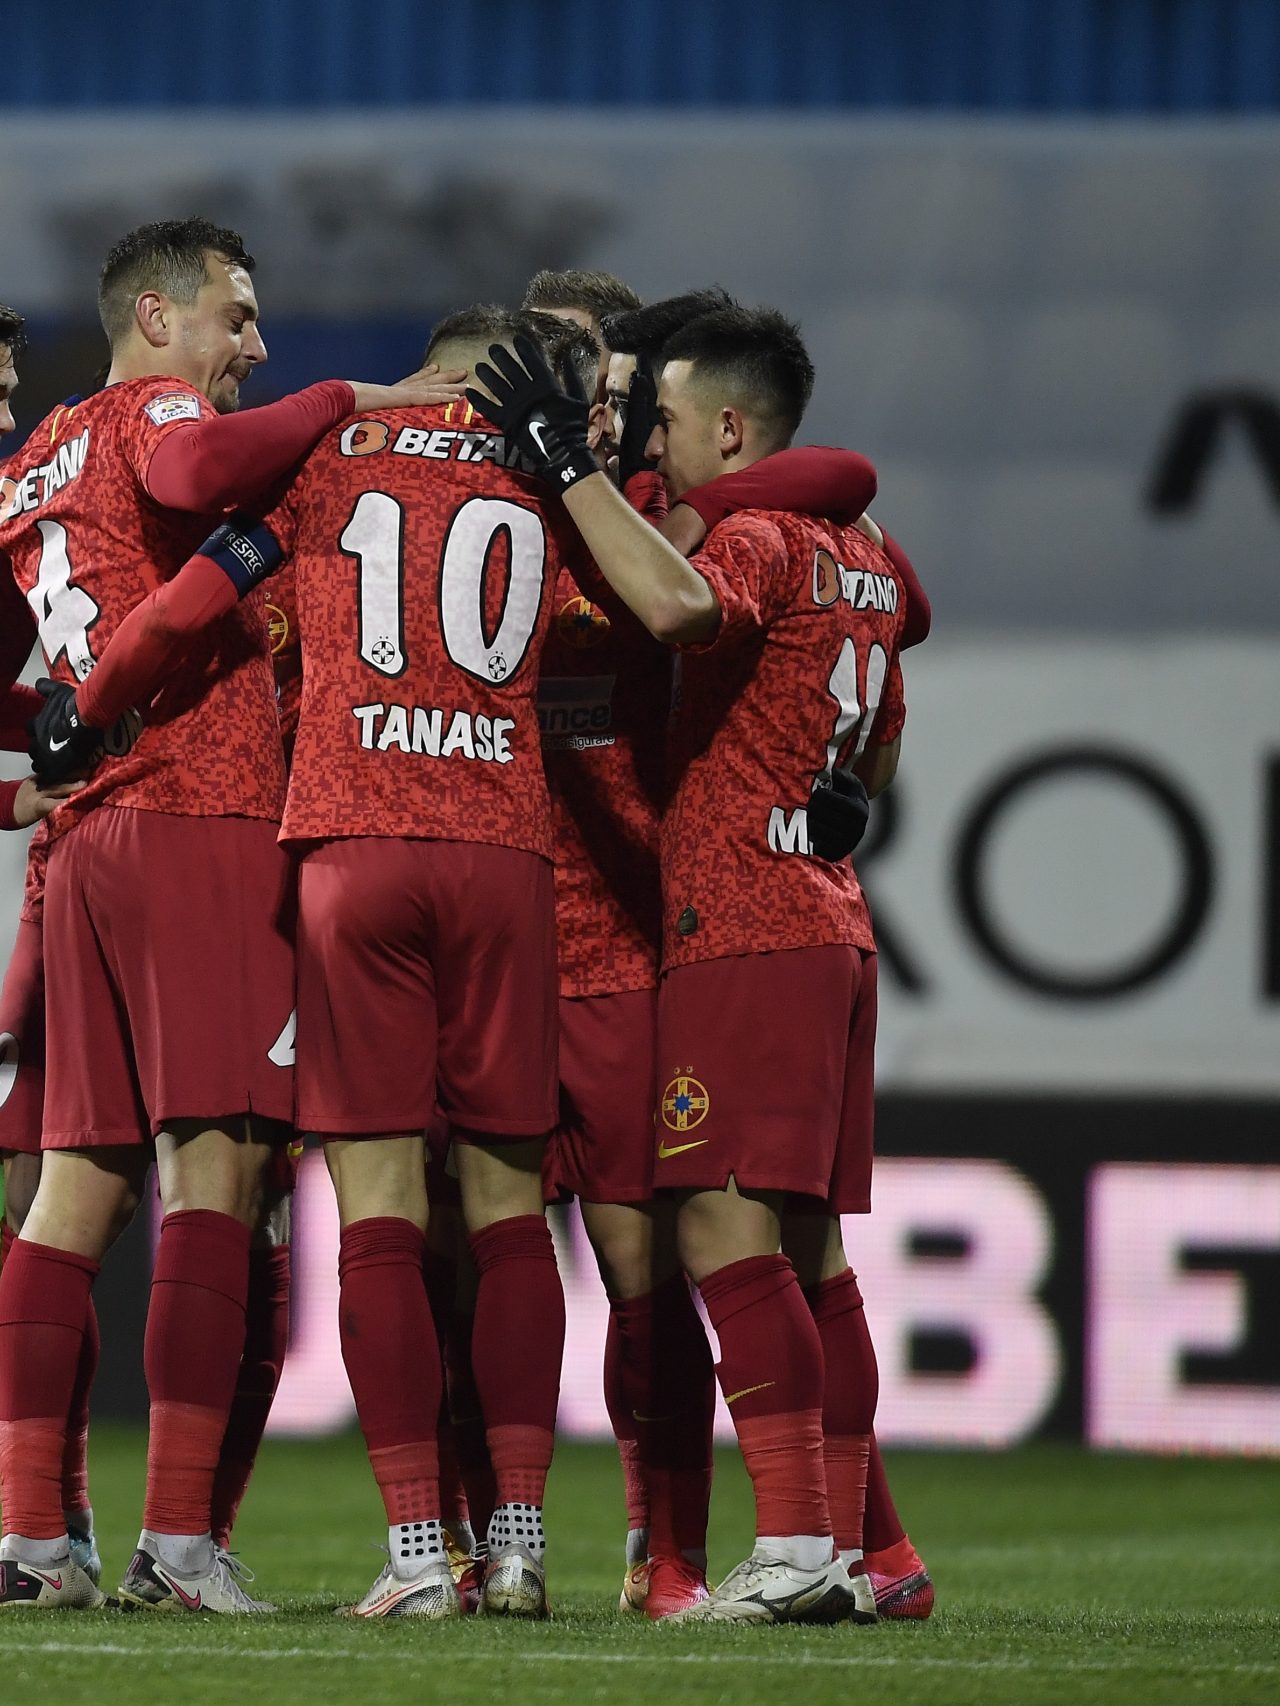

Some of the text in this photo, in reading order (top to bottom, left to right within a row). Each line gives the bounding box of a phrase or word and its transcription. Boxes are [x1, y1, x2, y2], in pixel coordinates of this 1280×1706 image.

[26, 519, 100, 684] 4
[224, 532, 265, 574] RESPEC
[338, 490, 547, 685] 10
[351, 702, 517, 765] TANASE
